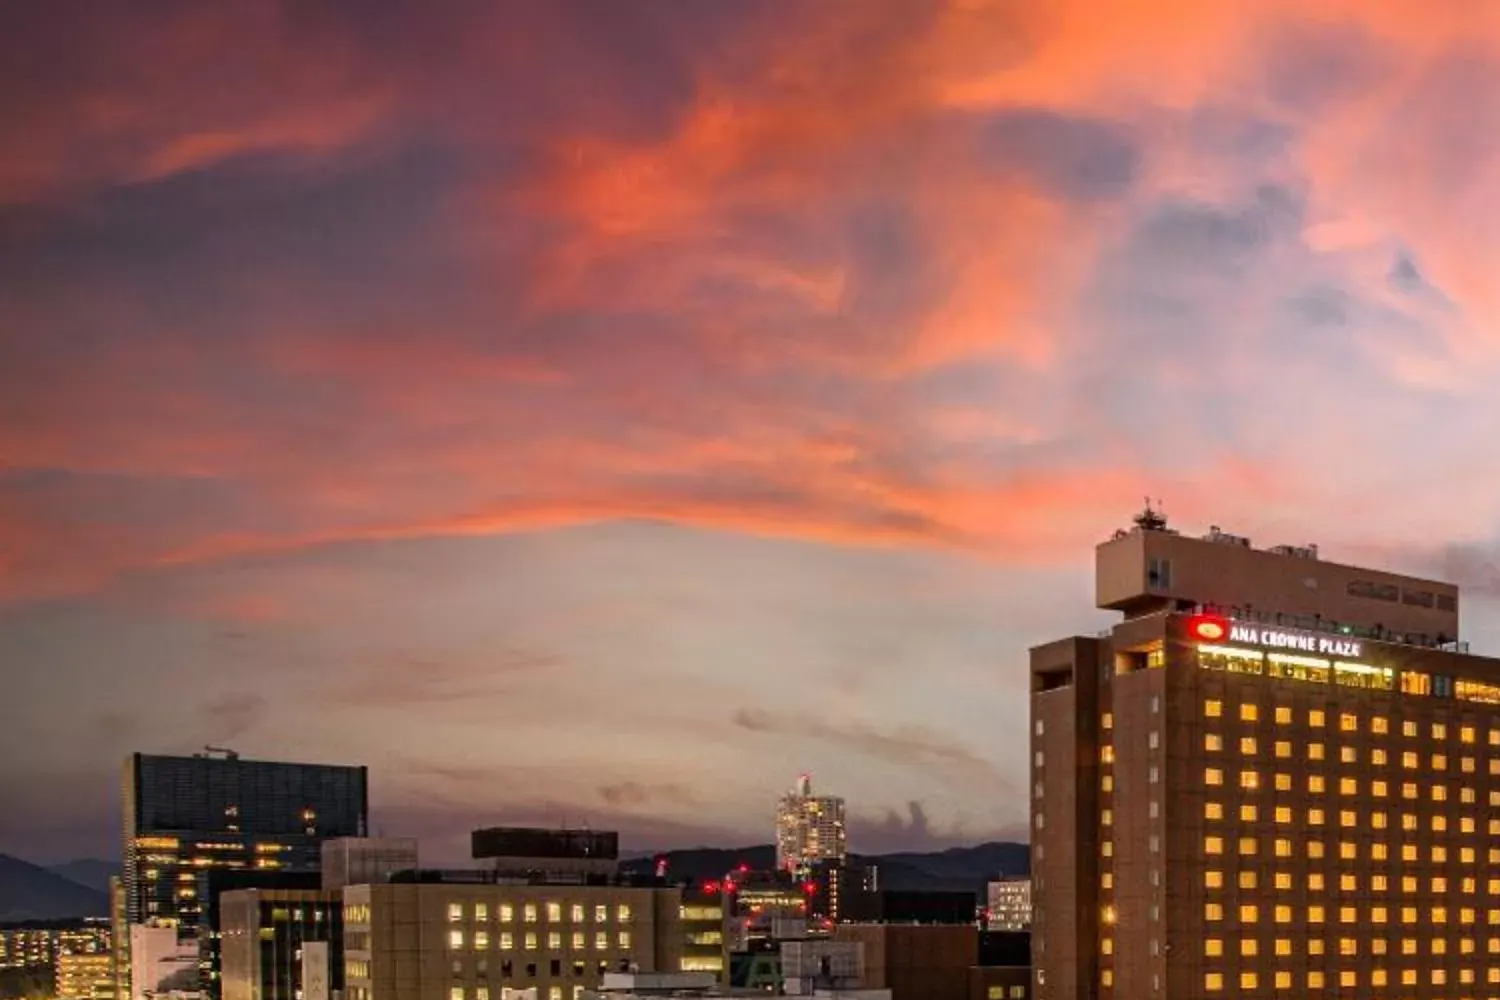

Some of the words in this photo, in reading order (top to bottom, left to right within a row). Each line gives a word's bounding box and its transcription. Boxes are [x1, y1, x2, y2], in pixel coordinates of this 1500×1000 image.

[1230, 626, 1257, 644] ANA
[1261, 630, 1316, 651] CROWNE
[1319, 638, 1362, 657] PLAZA
